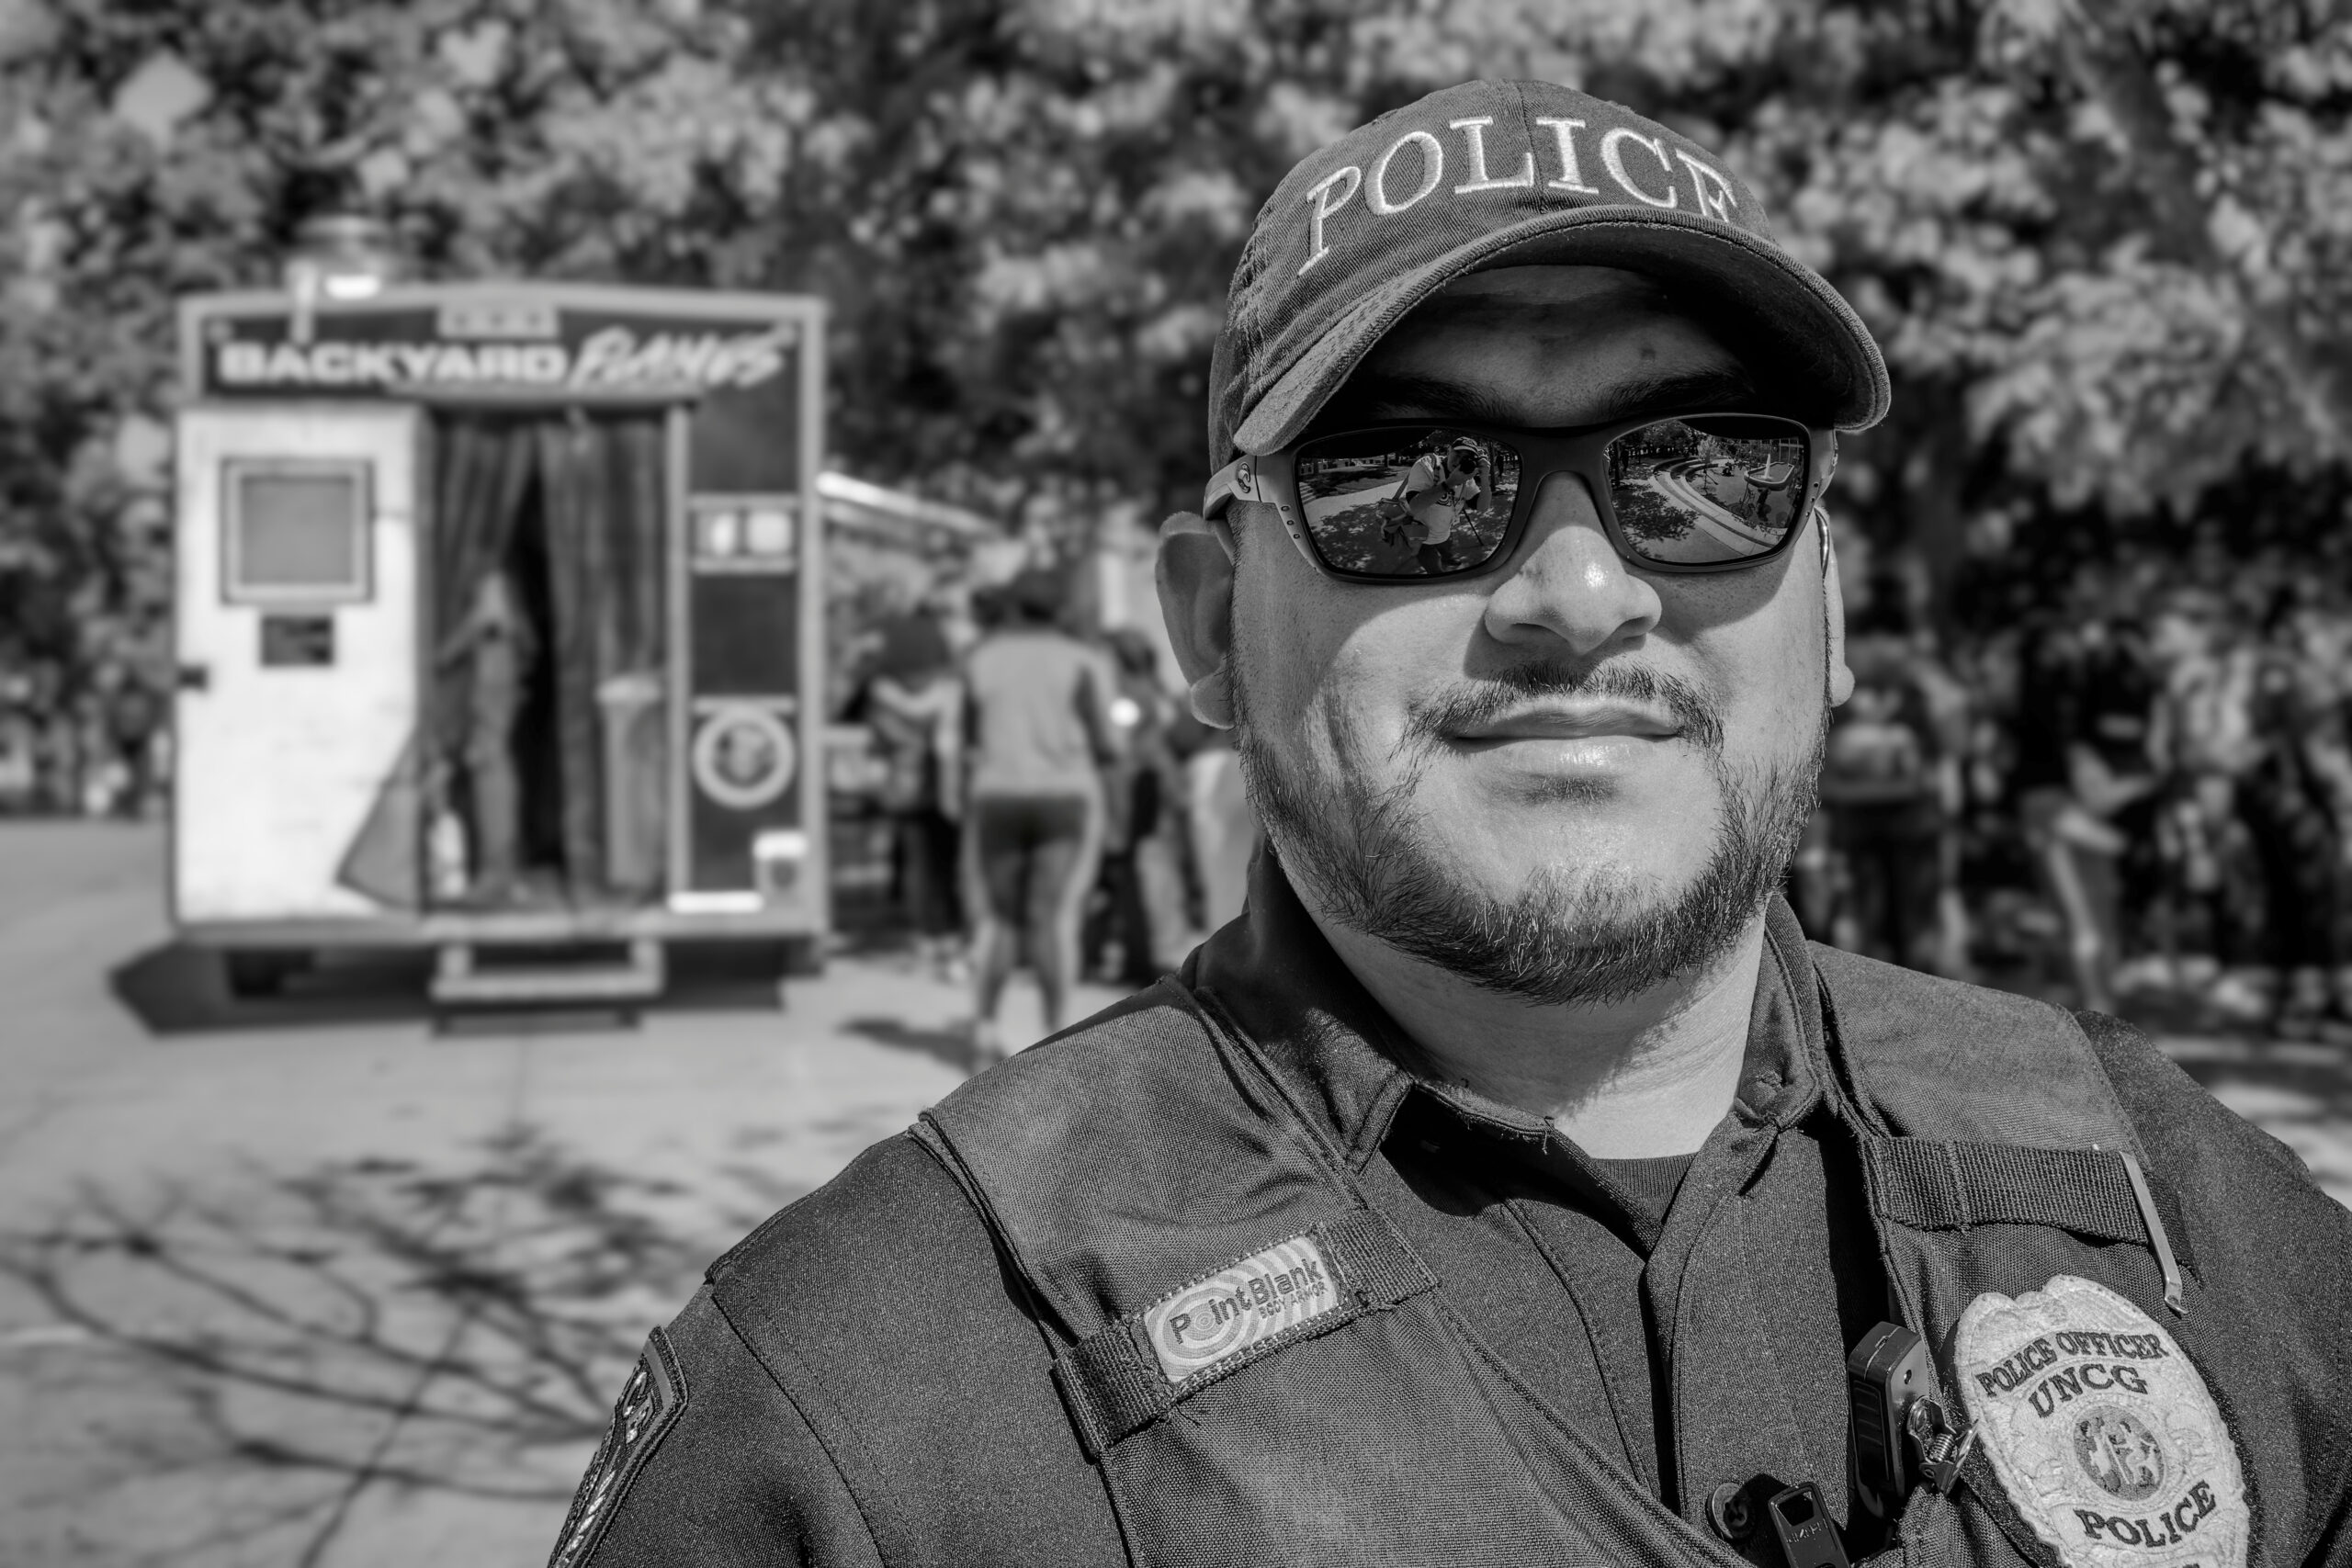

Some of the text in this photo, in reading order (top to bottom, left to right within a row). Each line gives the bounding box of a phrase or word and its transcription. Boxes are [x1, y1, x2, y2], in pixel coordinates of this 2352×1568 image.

[1298, 116, 1738, 276] POLICE
[219, 343, 568, 383] BACKYARD
[1976, 1331, 2170, 1398] POLICE OFFICER
[2028, 1363, 2149, 1418] UNCG
[2073, 1480, 2217, 1548] POLICE
